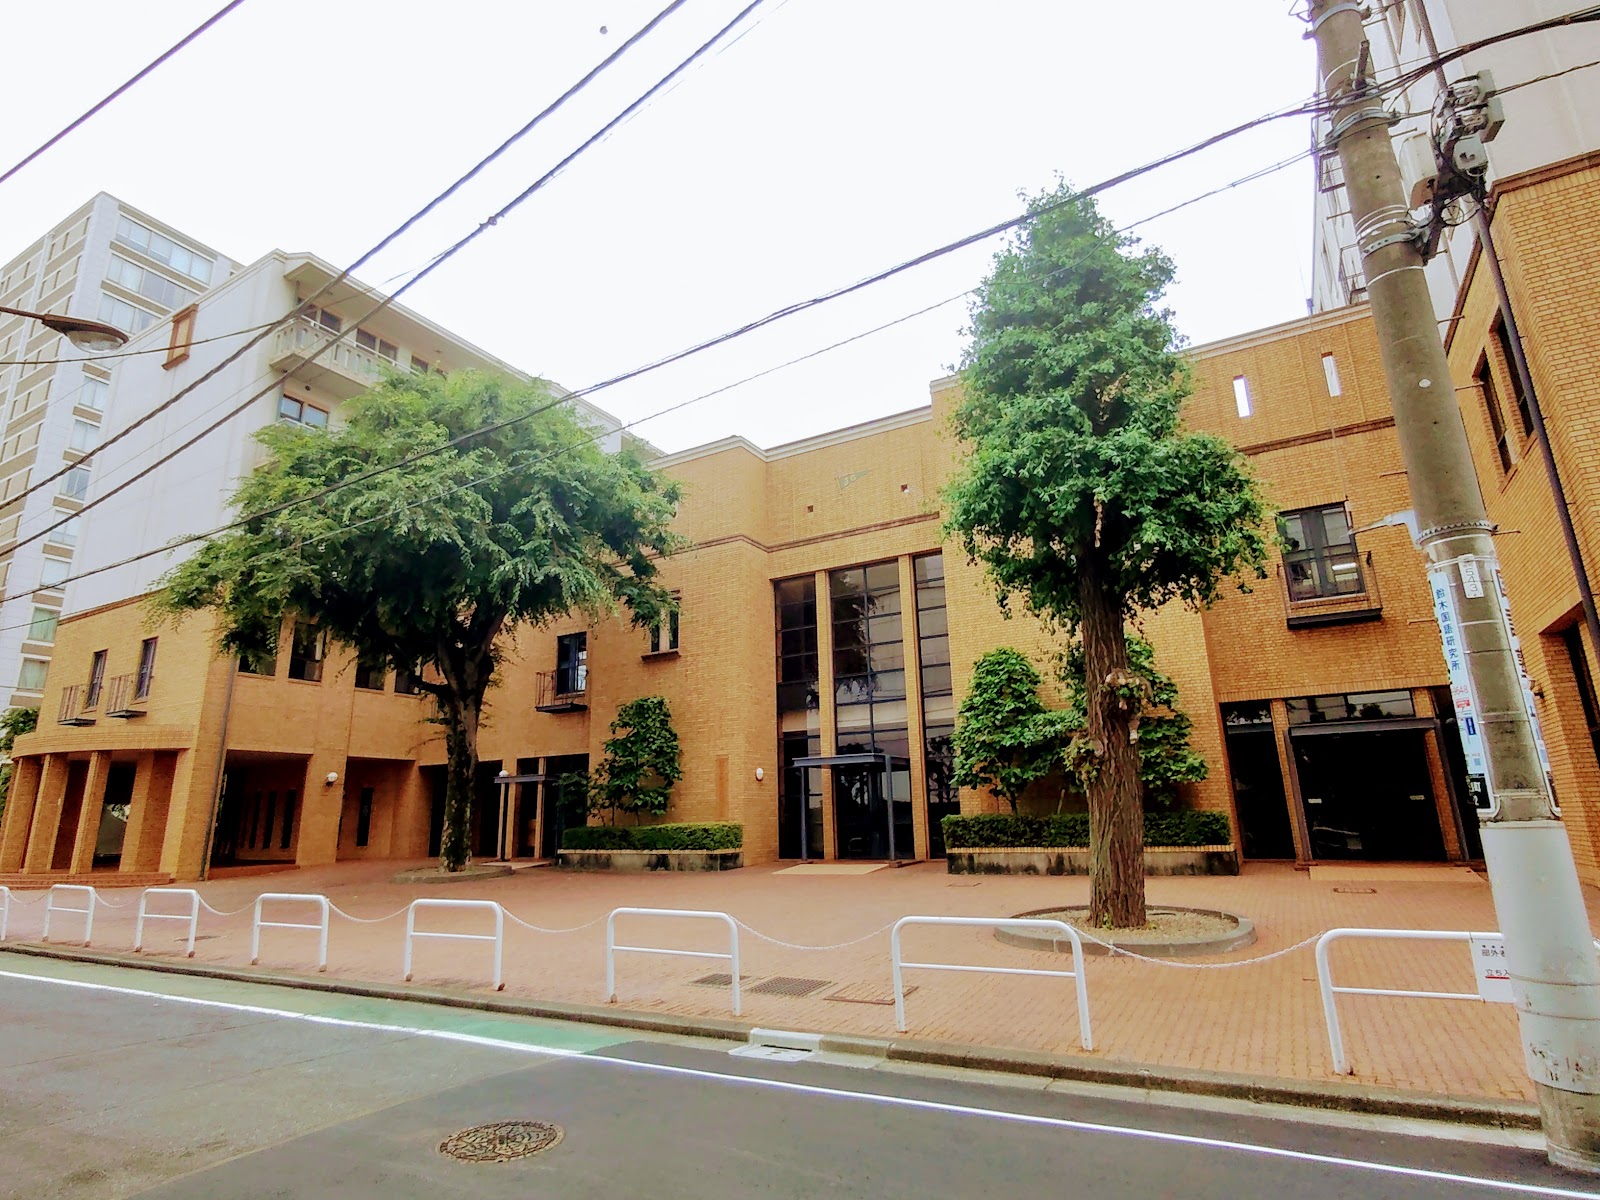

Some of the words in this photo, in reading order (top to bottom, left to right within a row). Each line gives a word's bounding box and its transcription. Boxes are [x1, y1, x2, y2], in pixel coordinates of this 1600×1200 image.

[1465, 568, 1478, 592] 543
[1435, 587, 1461, 671] 鈴木国語研究所
